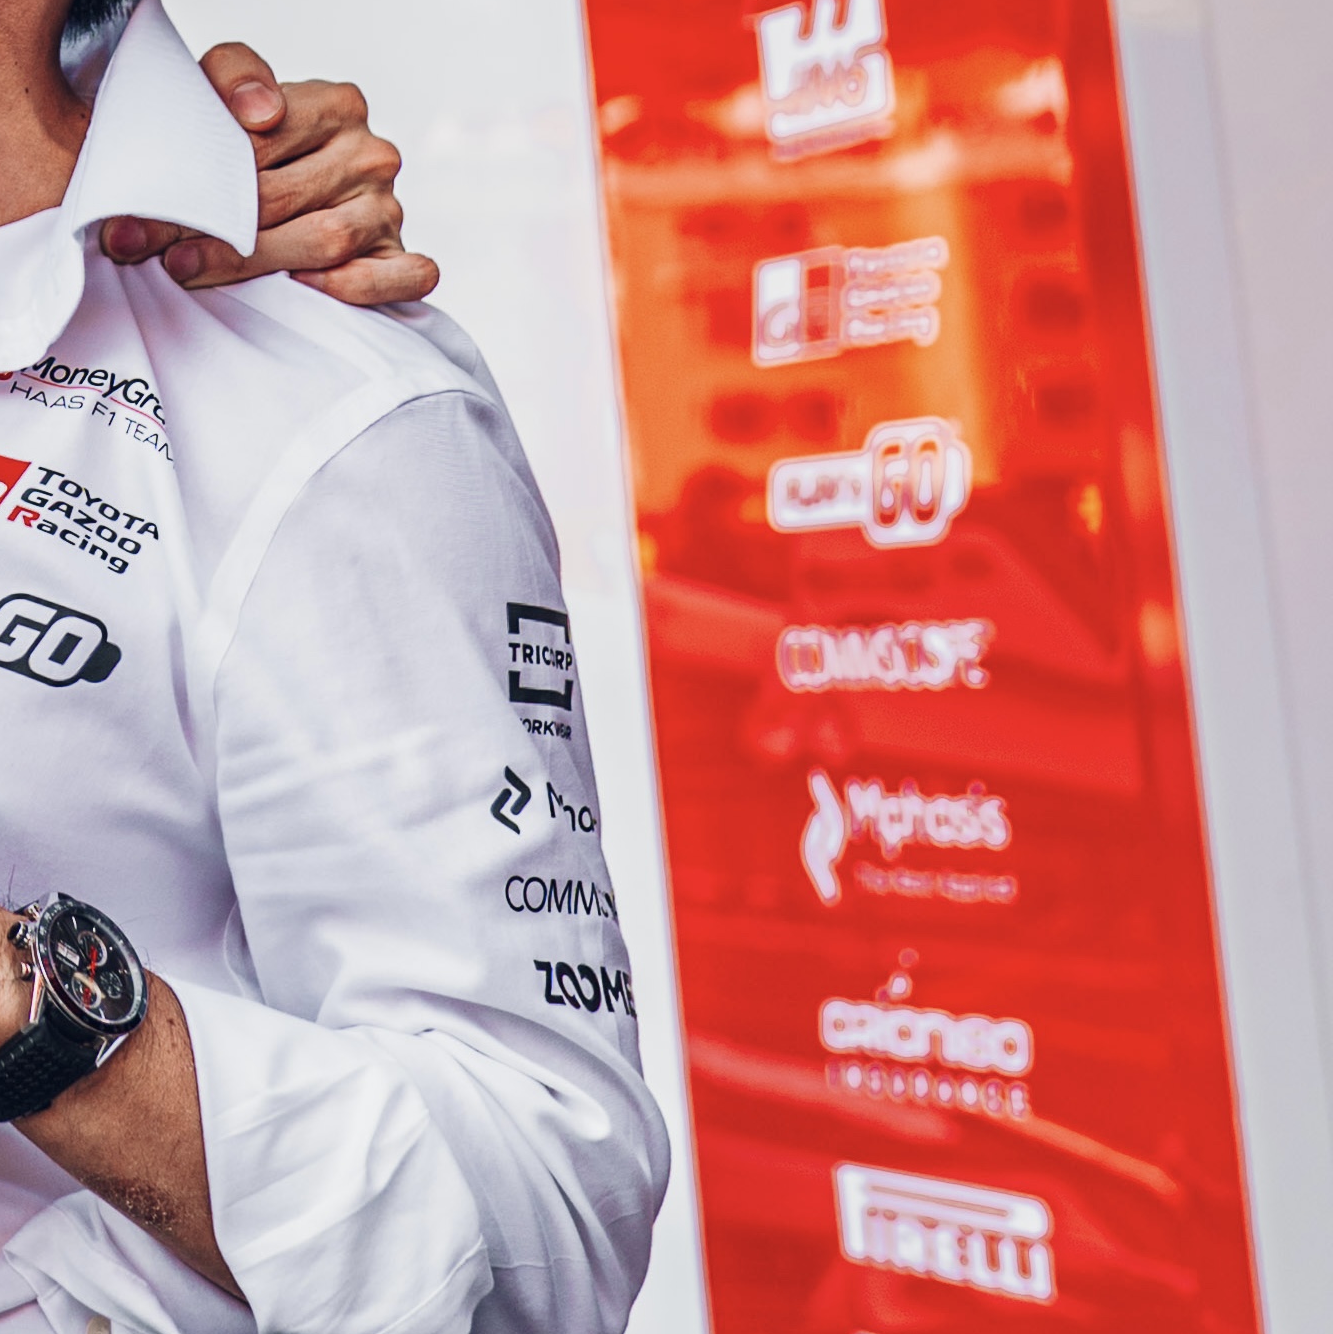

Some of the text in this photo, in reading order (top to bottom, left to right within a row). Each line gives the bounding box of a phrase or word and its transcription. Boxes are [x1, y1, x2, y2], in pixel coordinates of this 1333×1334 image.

[10, 381, 85, 409] HAAS
[91, 401, 116, 426] F1
[20, 488, 141, 555] GAZOO
[37, 466, 160, 541] TOYOTA
[7, 507, 129, 574] Racing
